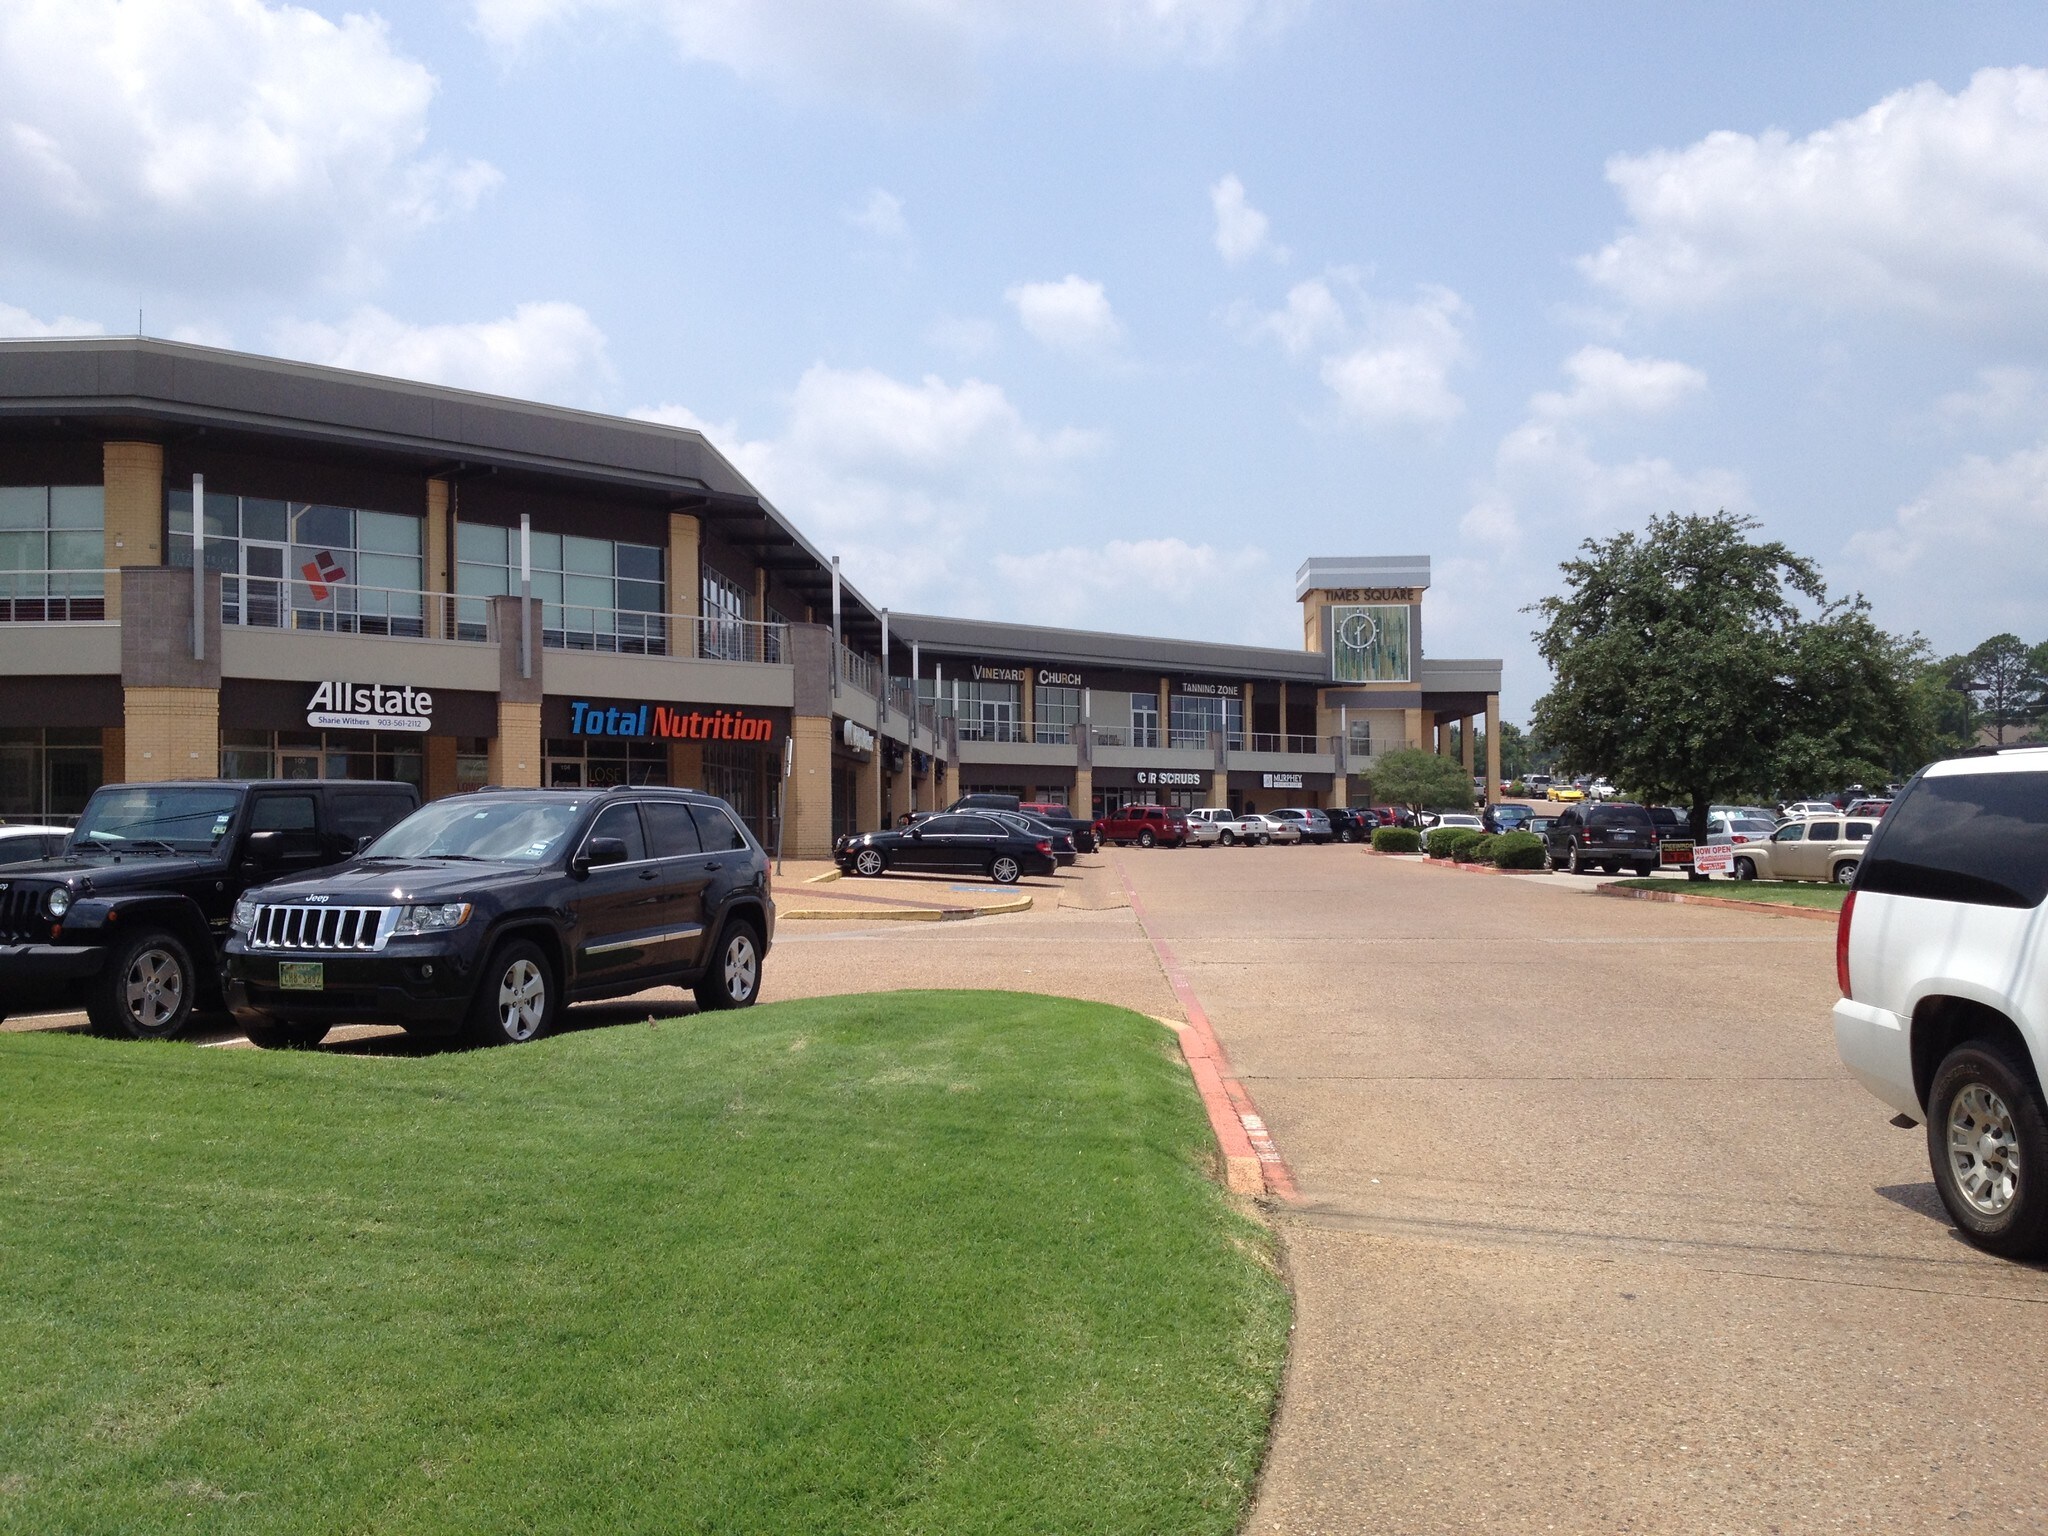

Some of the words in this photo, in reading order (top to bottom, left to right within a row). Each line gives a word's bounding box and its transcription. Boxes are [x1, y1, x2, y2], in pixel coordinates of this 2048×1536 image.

[1324, 589, 1360, 601] TIMES
[1364, 589, 1414, 601] SQUARE
[972, 664, 1026, 681] VINEYARD
[1039, 669, 1081, 685] CHURCH
[1182, 682, 1216, 694] TANNING
[1217, 685, 1239, 696] ZONE
[306, 681, 433, 715] Allstate
[341, 717, 370, 726] Withers
[377, 718, 422, 728] 903-561-2112
[572, 702, 647, 736] Total
[652, 707, 772, 741] Nutrition
[588, 766, 622, 783] LOSE
[1137, 771, 1147, 784] C
[1148, 772, 1157, 785] R
[1158, 772, 1201, 785] SCRUBS
[1273, 774, 1303, 783] MURPHEY
[1695, 847, 1711, 856] NOW
[1712, 845, 1731, 854] OPEN
[305, 893, 330, 903] Jeep
